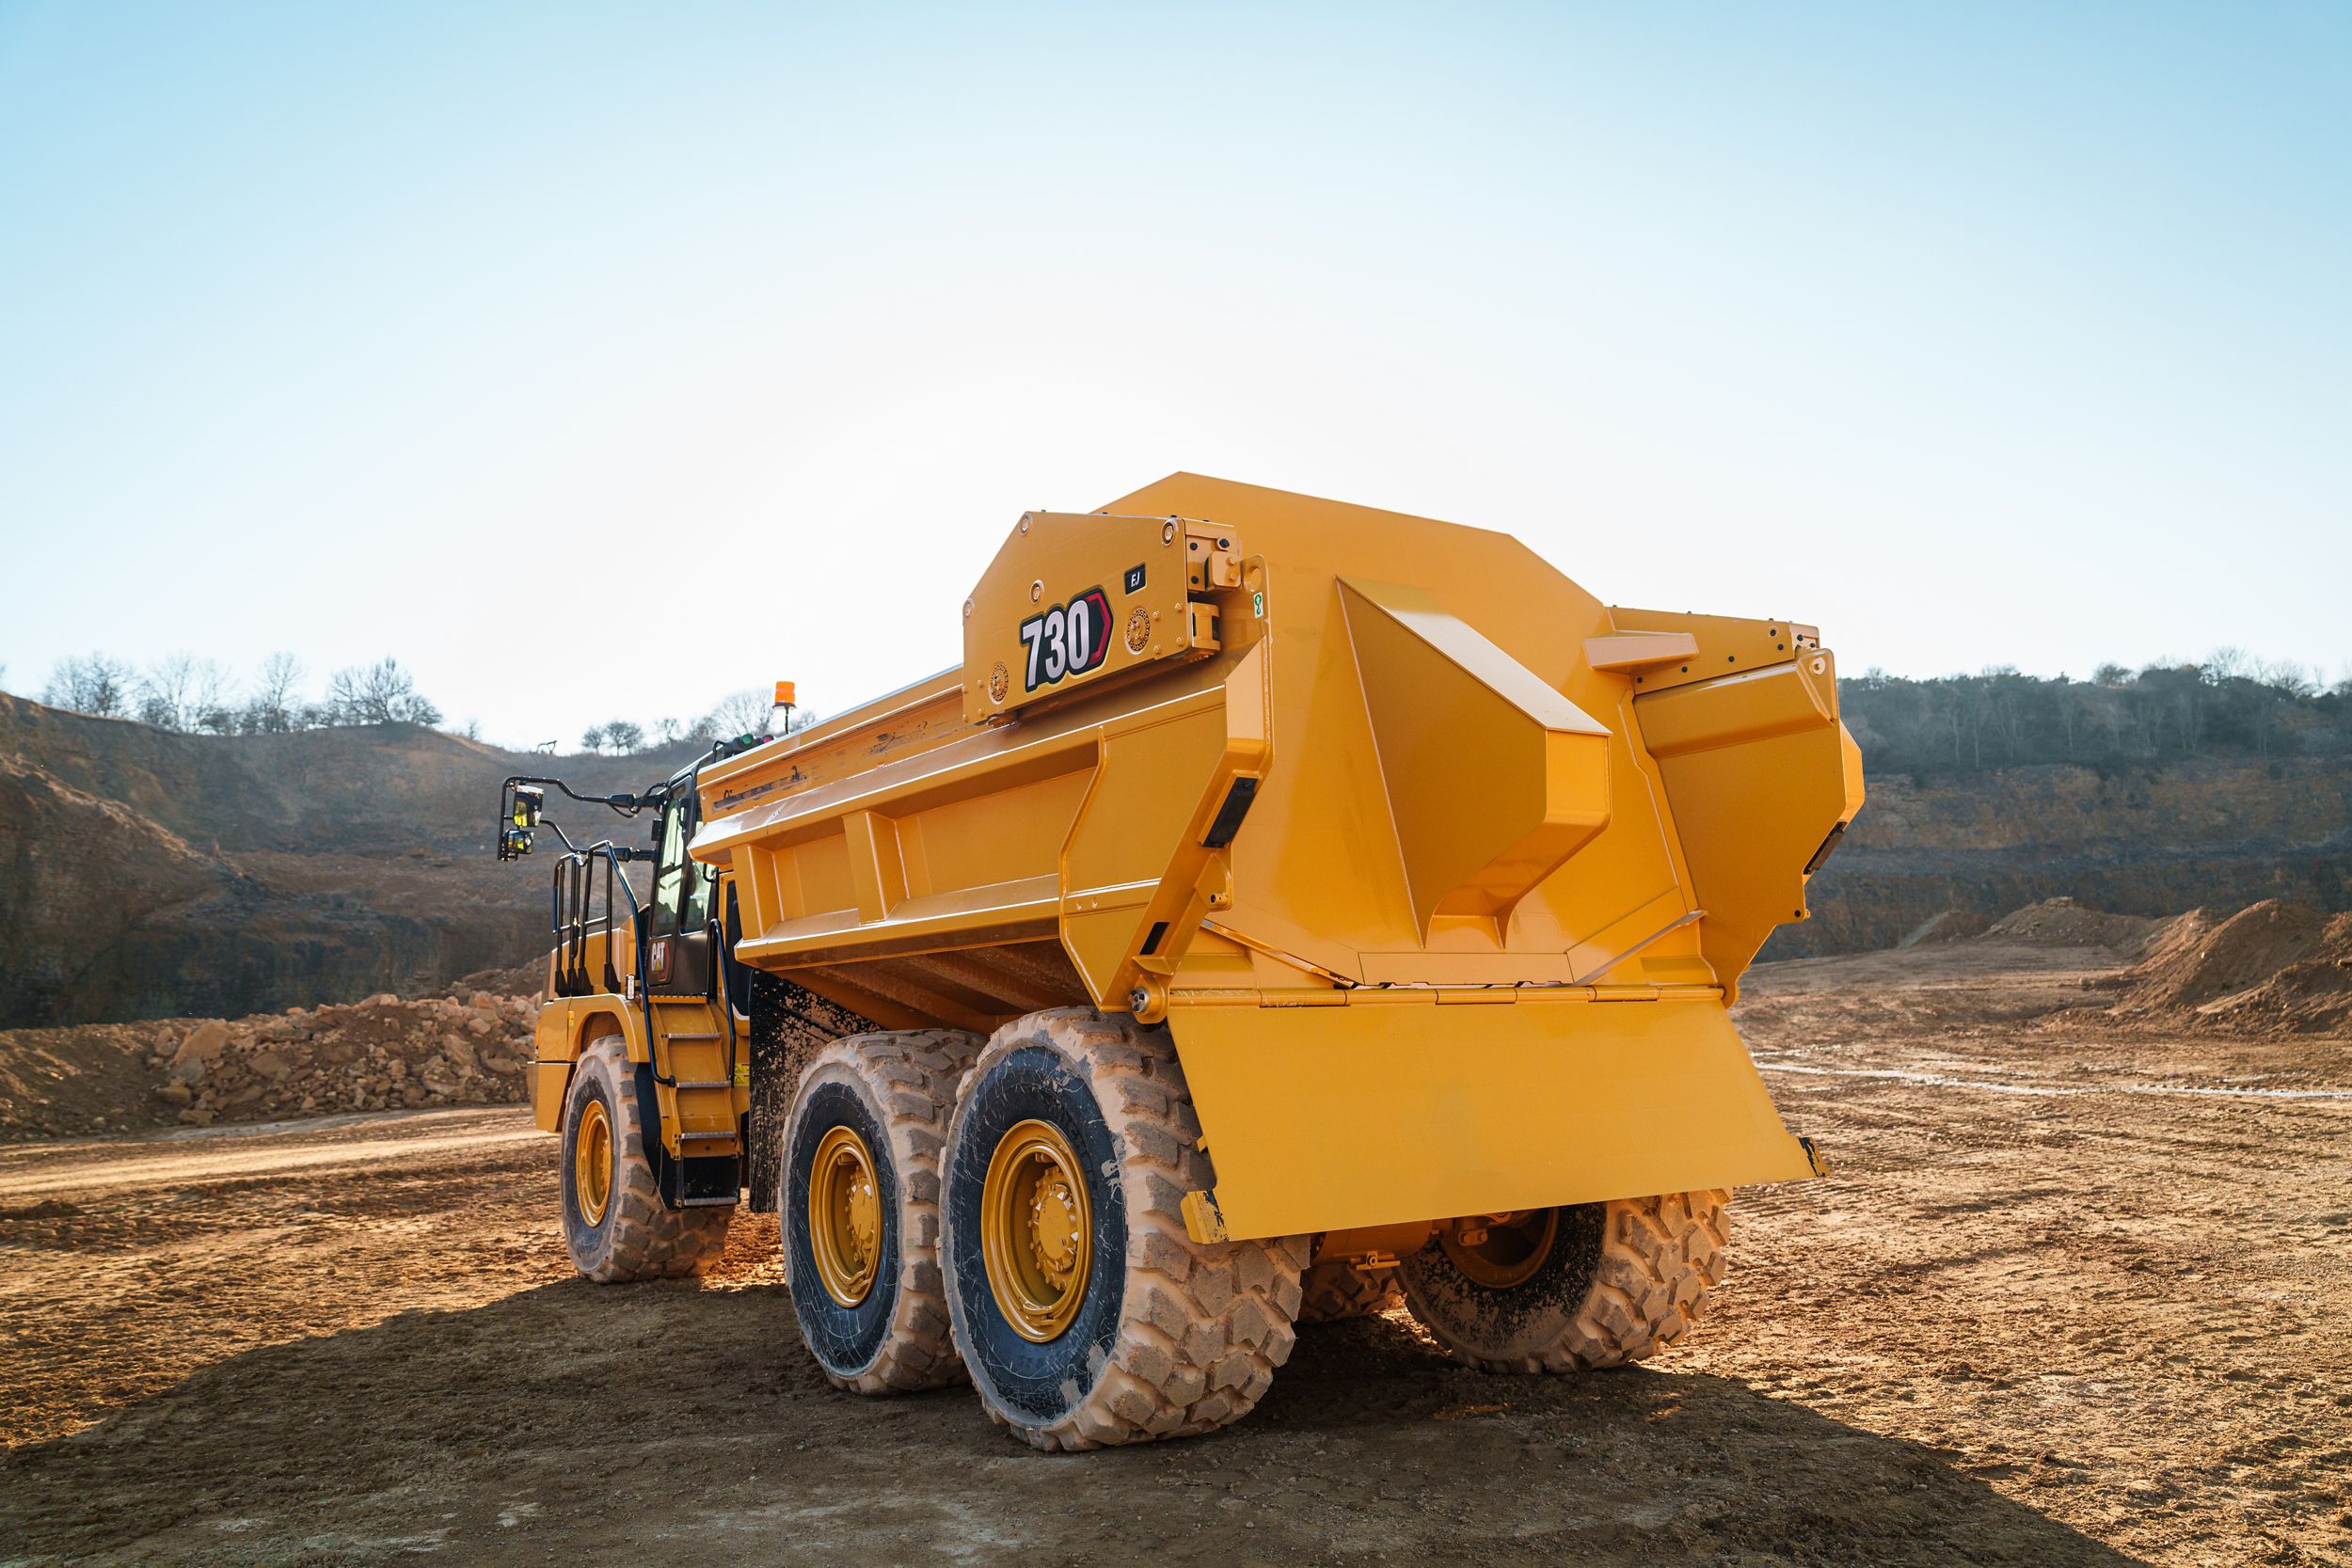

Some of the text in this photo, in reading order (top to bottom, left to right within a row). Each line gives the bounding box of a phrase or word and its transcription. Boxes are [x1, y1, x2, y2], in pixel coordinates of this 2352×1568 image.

[1131, 571, 1140, 587] EJ
[1023, 600, 1089, 687] 730
[651, 942, 665, 972] CAT
